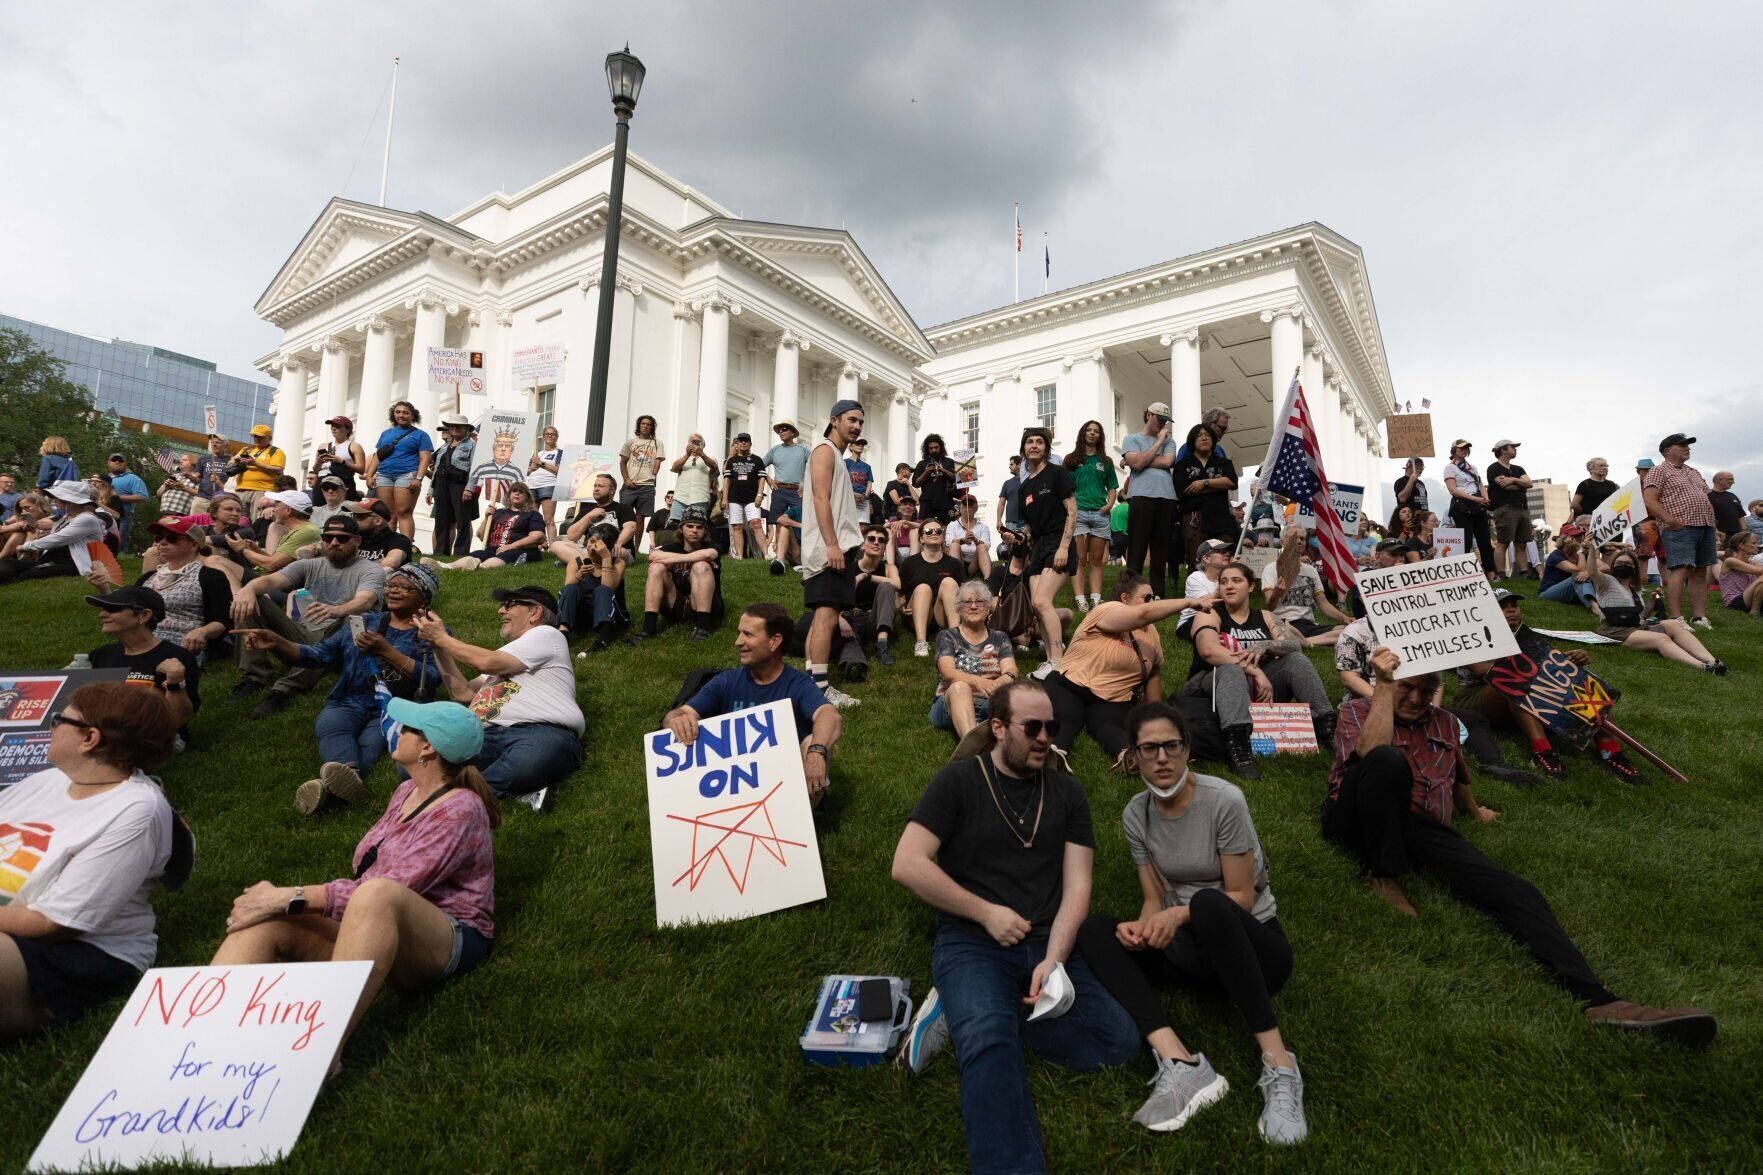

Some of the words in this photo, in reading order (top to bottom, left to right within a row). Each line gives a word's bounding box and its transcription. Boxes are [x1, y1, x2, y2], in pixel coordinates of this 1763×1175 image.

[428, 347, 454, 357] AMERICA
[454, 349, 467, 359] HAS
[433, 357, 444, 366] NO
[445, 358, 462, 367] KING
[434, 375, 445, 384] NO
[456, 368, 473, 377] NEEDS
[492, 414, 526, 425] CRIMINALS
[1360, 574, 1397, 595] SAVE
[1371, 593, 1436, 616] CONTROL
[1436, 581, 1489, 602] TRUMP'S
[1384, 606, 1483, 639] AUTOCRATIC
[1229, 627, 1267, 640] ABORT
[1401, 625, 1494, 663] IMPULSES!
[1491, 652, 1539, 697] NO
[1519, 649, 1579, 725] KINGS
[16, 699, 50, 709] RISE
[11, 710, 32, 720] UP
[0, 743, 50, 757] DEMOCR
[652, 709, 778, 777] KINGS
[0, 757, 14, 767] IES
[15, 757, 28, 766] IN
[28, 756, 48, 765] SILE
[698, 762, 759, 798] NO
[238, 972, 325, 1051] King
[170, 1041, 212, 1081] for
[222, 1062, 277, 1100] my
